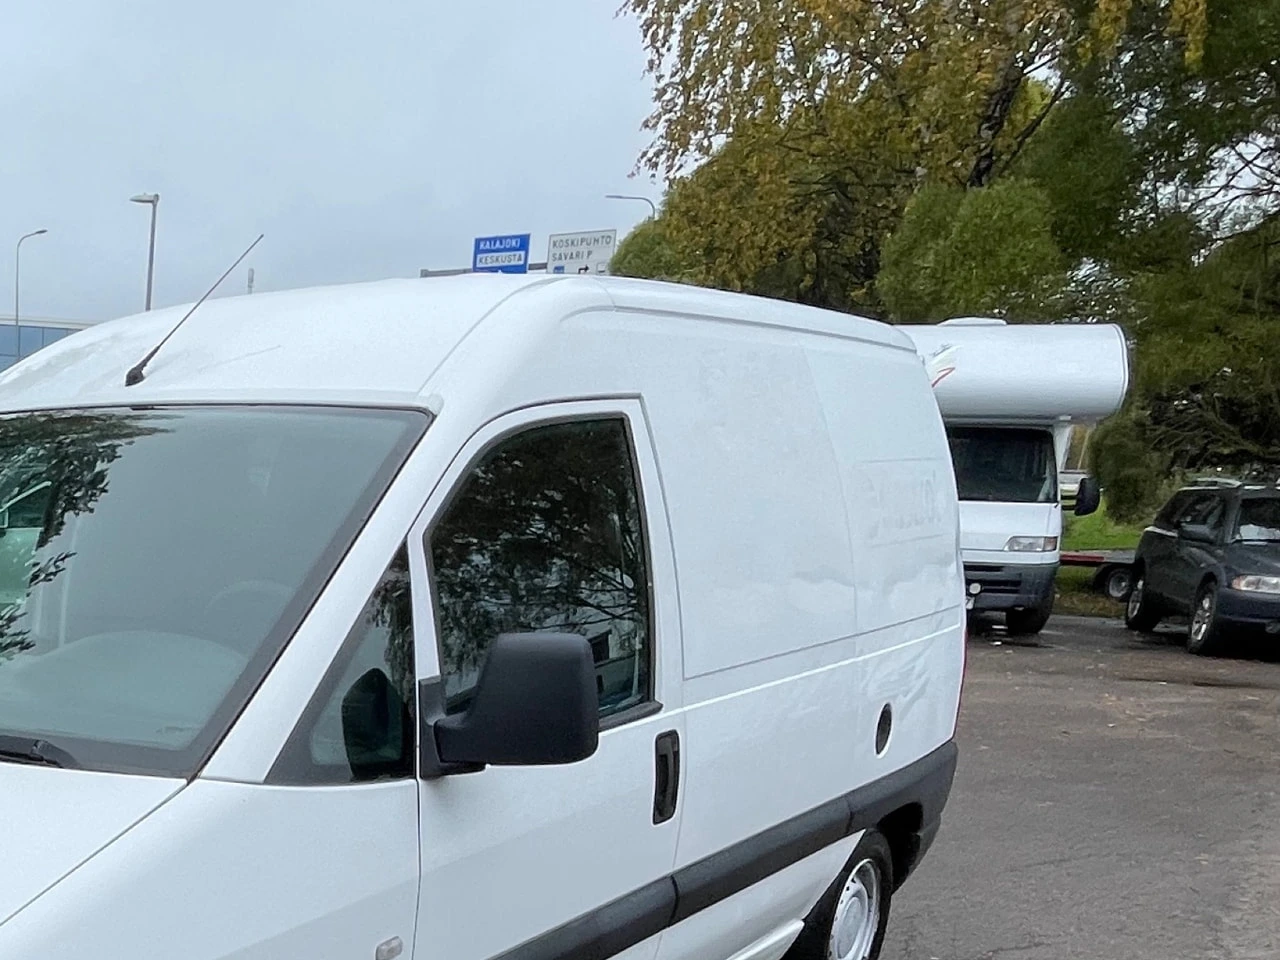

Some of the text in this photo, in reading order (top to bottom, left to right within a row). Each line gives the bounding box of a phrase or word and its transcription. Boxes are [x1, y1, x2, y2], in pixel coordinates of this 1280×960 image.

[479, 237, 521, 250] KALAJOKI
[552, 235, 612, 249] KOSKIPUHTO
[478, 253, 523, 265] KESKUSTA
